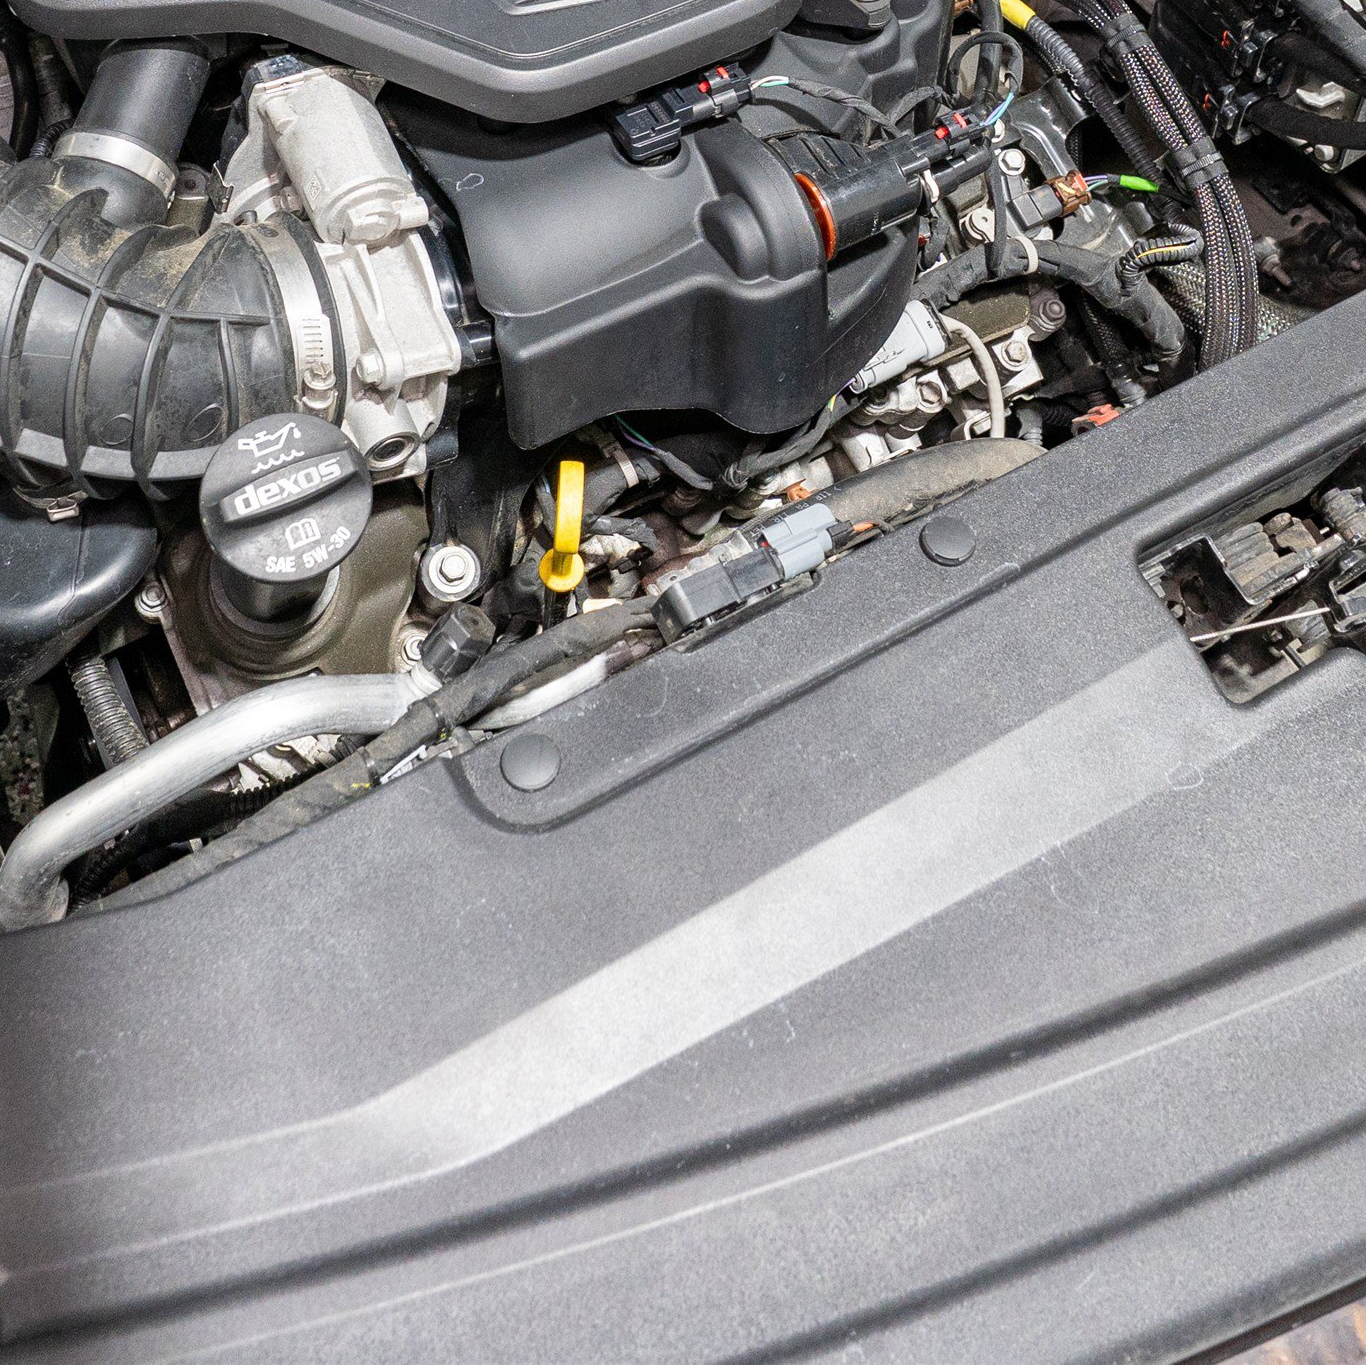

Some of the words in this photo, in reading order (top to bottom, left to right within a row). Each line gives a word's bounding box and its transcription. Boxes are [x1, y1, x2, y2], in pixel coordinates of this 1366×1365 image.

[233, 457, 342, 517] dexos
[265, 555, 296, 574] SAE
[303, 526, 352, 570] 5W-30
